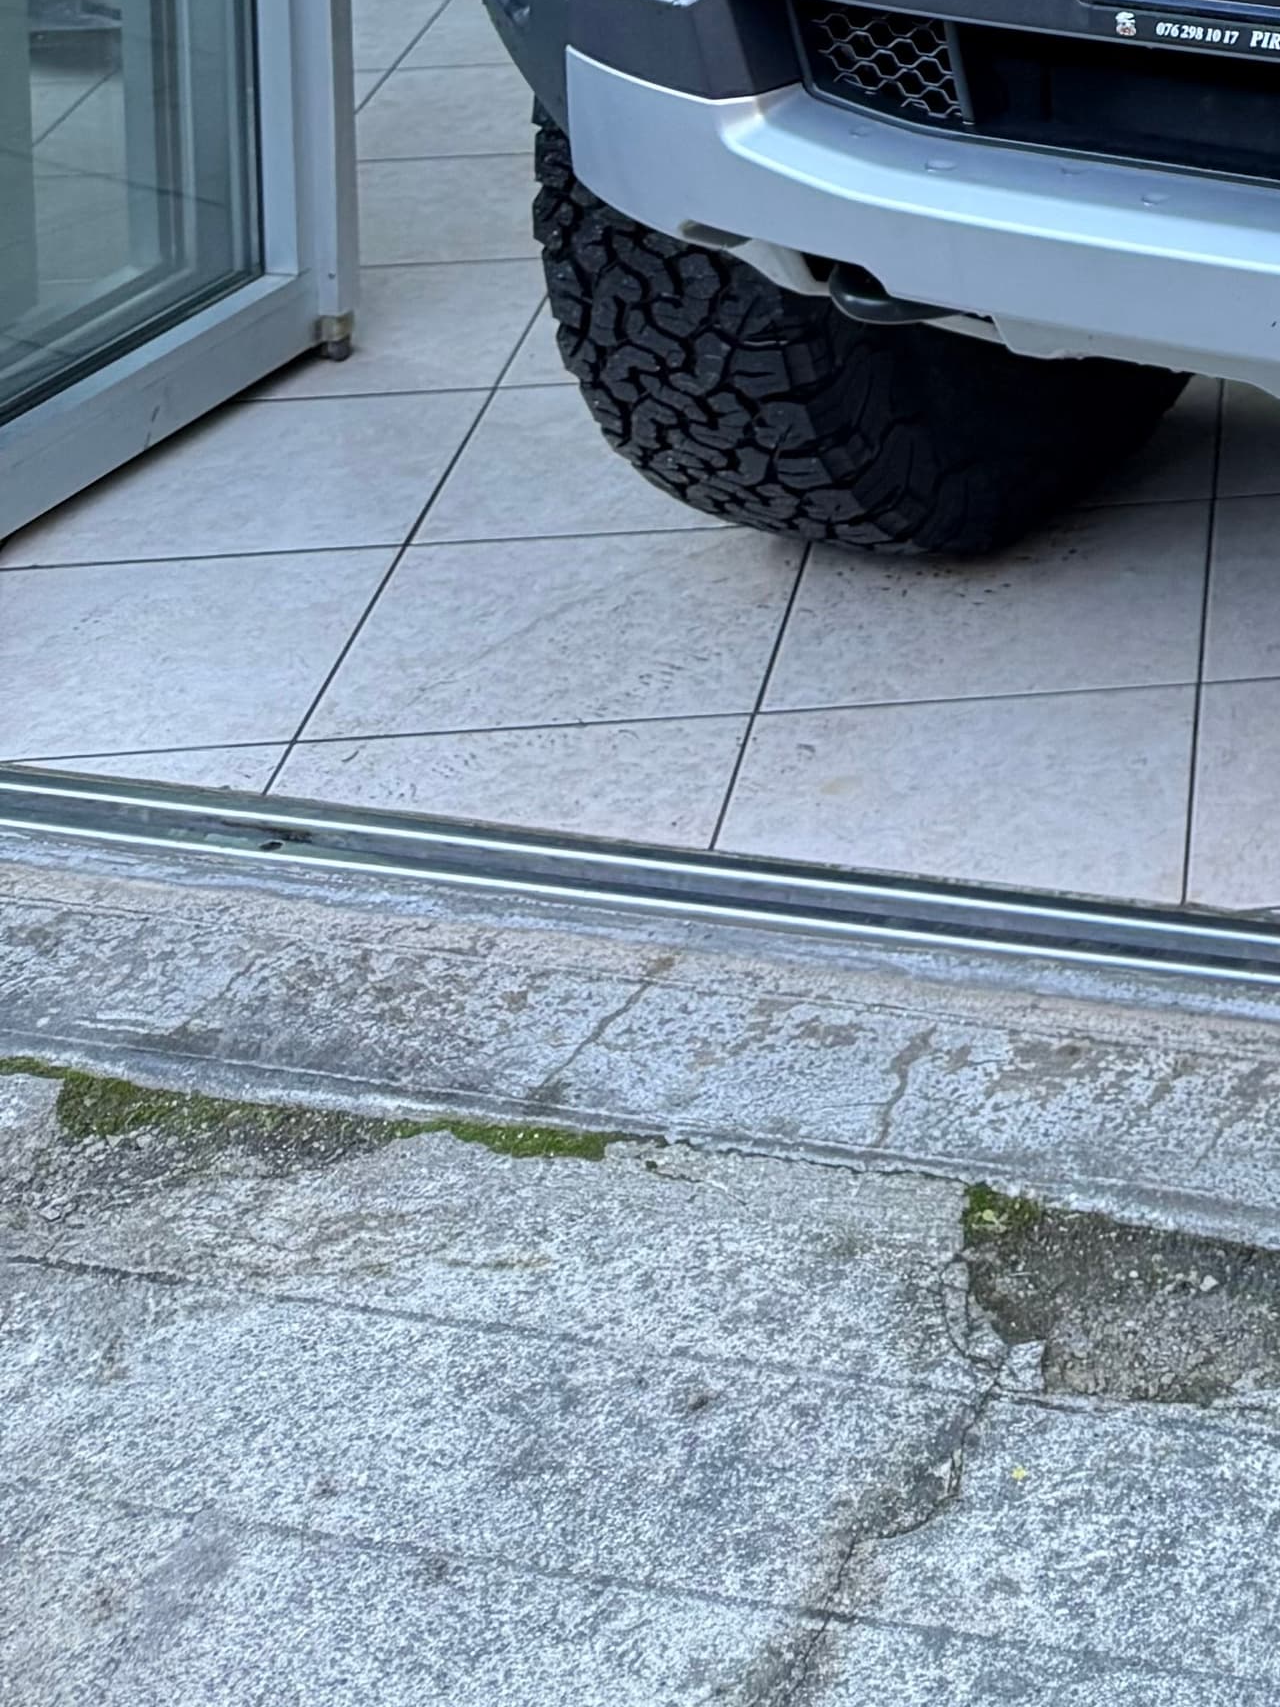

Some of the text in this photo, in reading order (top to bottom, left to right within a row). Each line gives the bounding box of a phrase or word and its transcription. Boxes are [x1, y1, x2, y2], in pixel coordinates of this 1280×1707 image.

[1155, 22, 1180, 37] 076
[1180, 25, 1204, 40] 298
[1205, 28, 1222, 43] 10
[1223, 30, 1240, 45] 17
